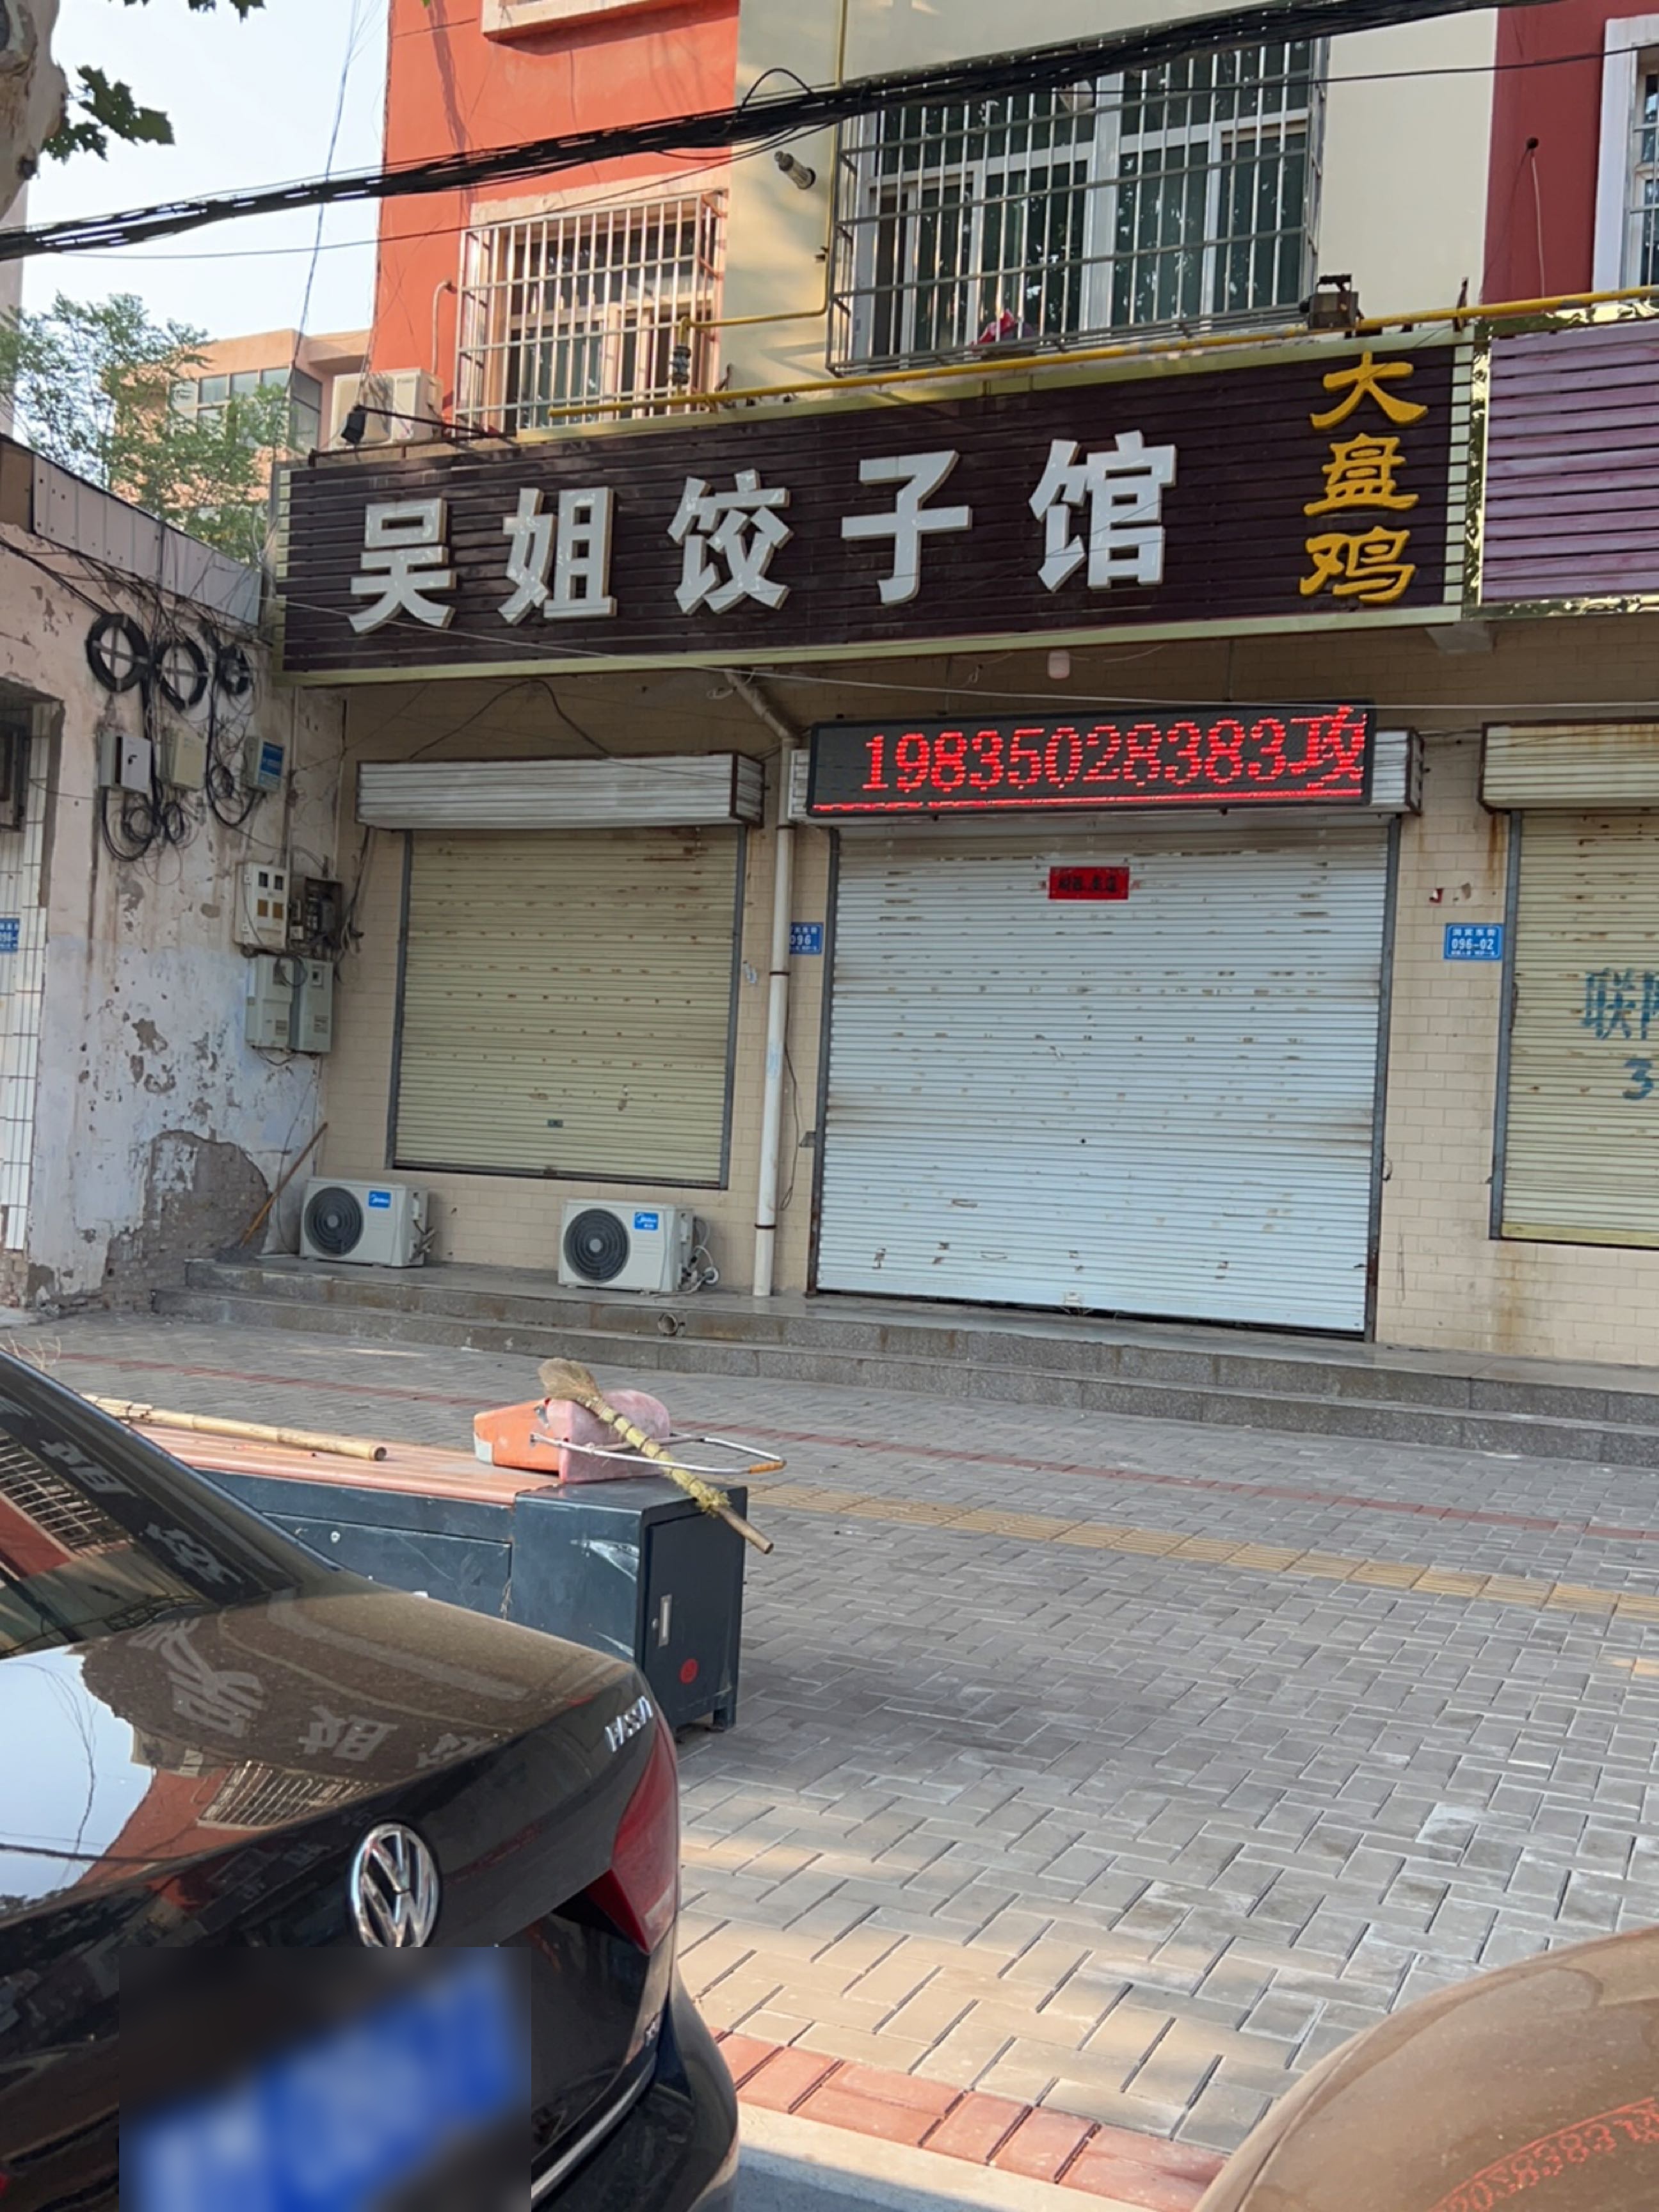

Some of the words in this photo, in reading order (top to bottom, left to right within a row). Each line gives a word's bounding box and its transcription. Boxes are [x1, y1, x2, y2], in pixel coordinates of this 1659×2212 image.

[348, 429, 1177, 635] 吴姐饺子馆
[1302, 350, 1427, 603] 大盘鸡
